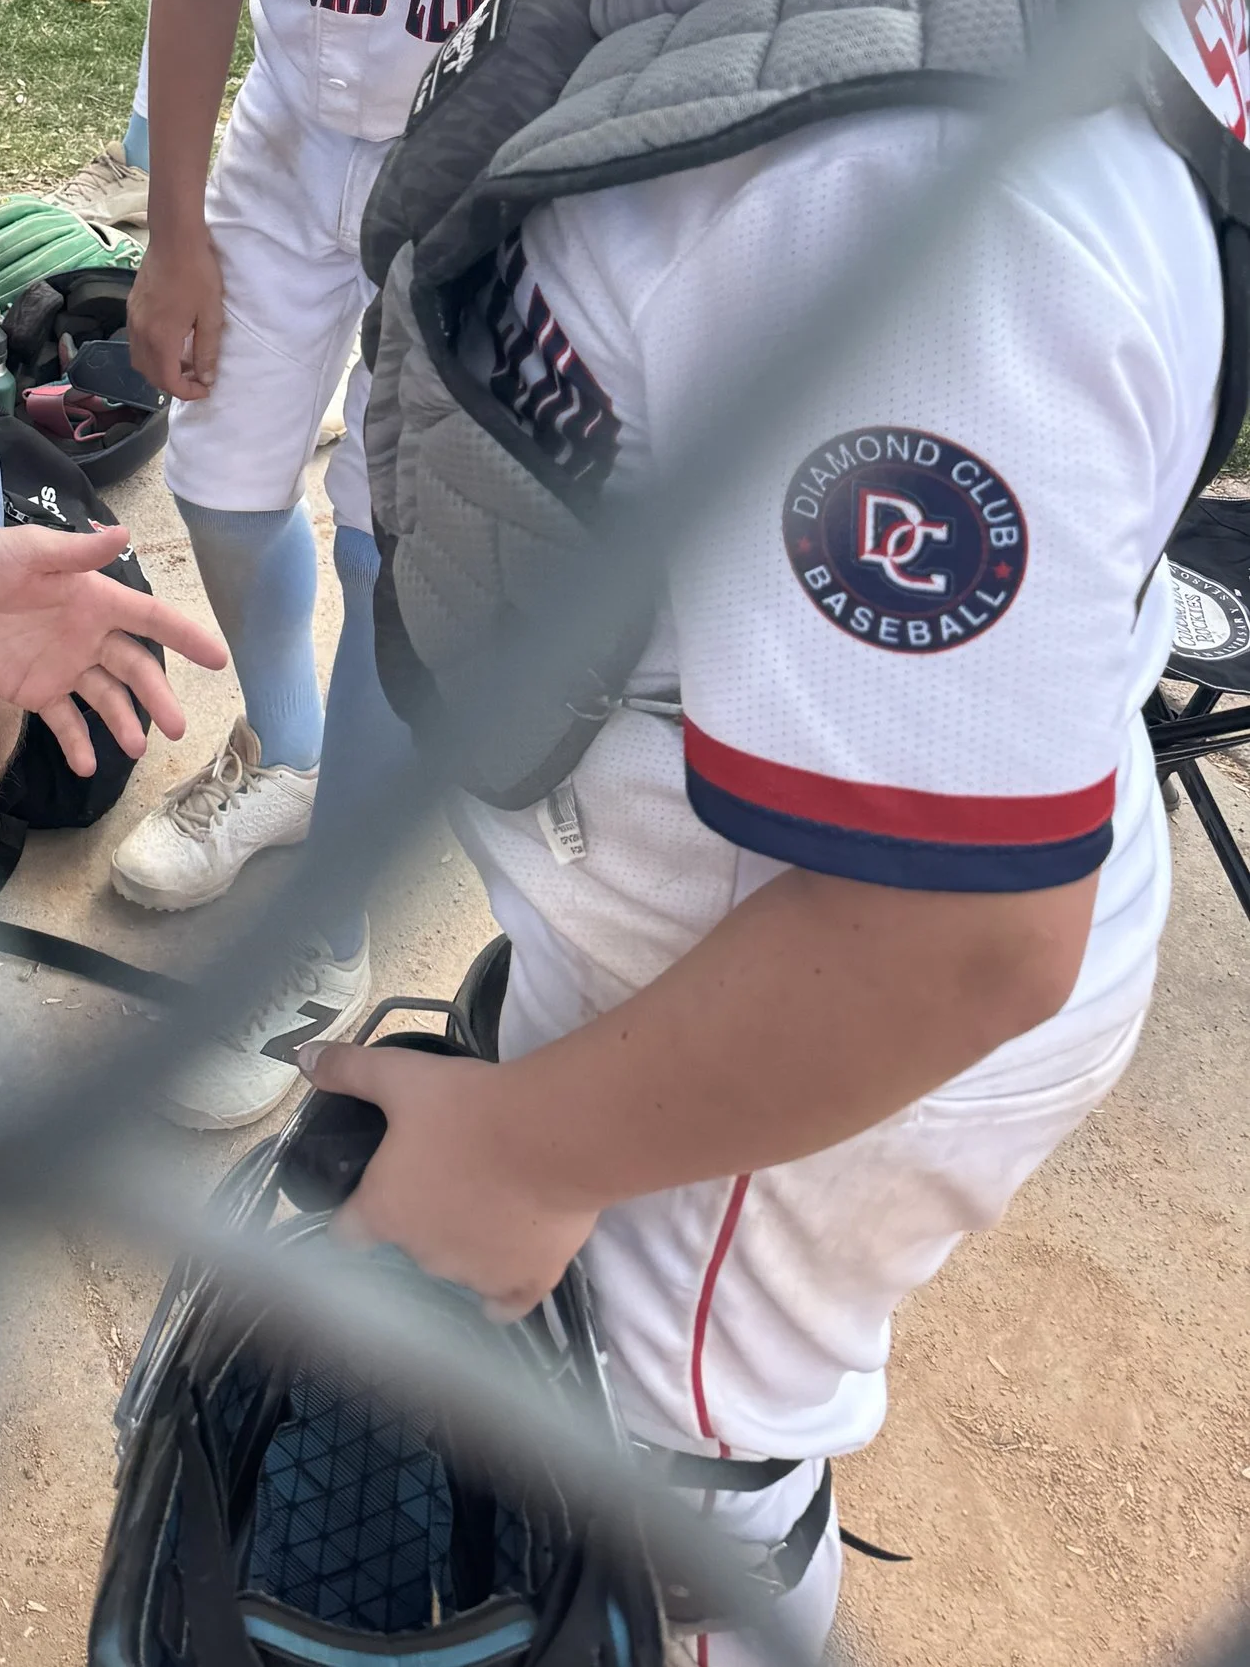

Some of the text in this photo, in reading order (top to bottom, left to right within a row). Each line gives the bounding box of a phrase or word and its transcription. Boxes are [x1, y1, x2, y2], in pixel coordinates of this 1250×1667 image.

[793, 434, 1019, 549] DIAMOND CLUB
[858, 487, 948, 592] DC
[804, 565, 1007, 647] BASEBALL
